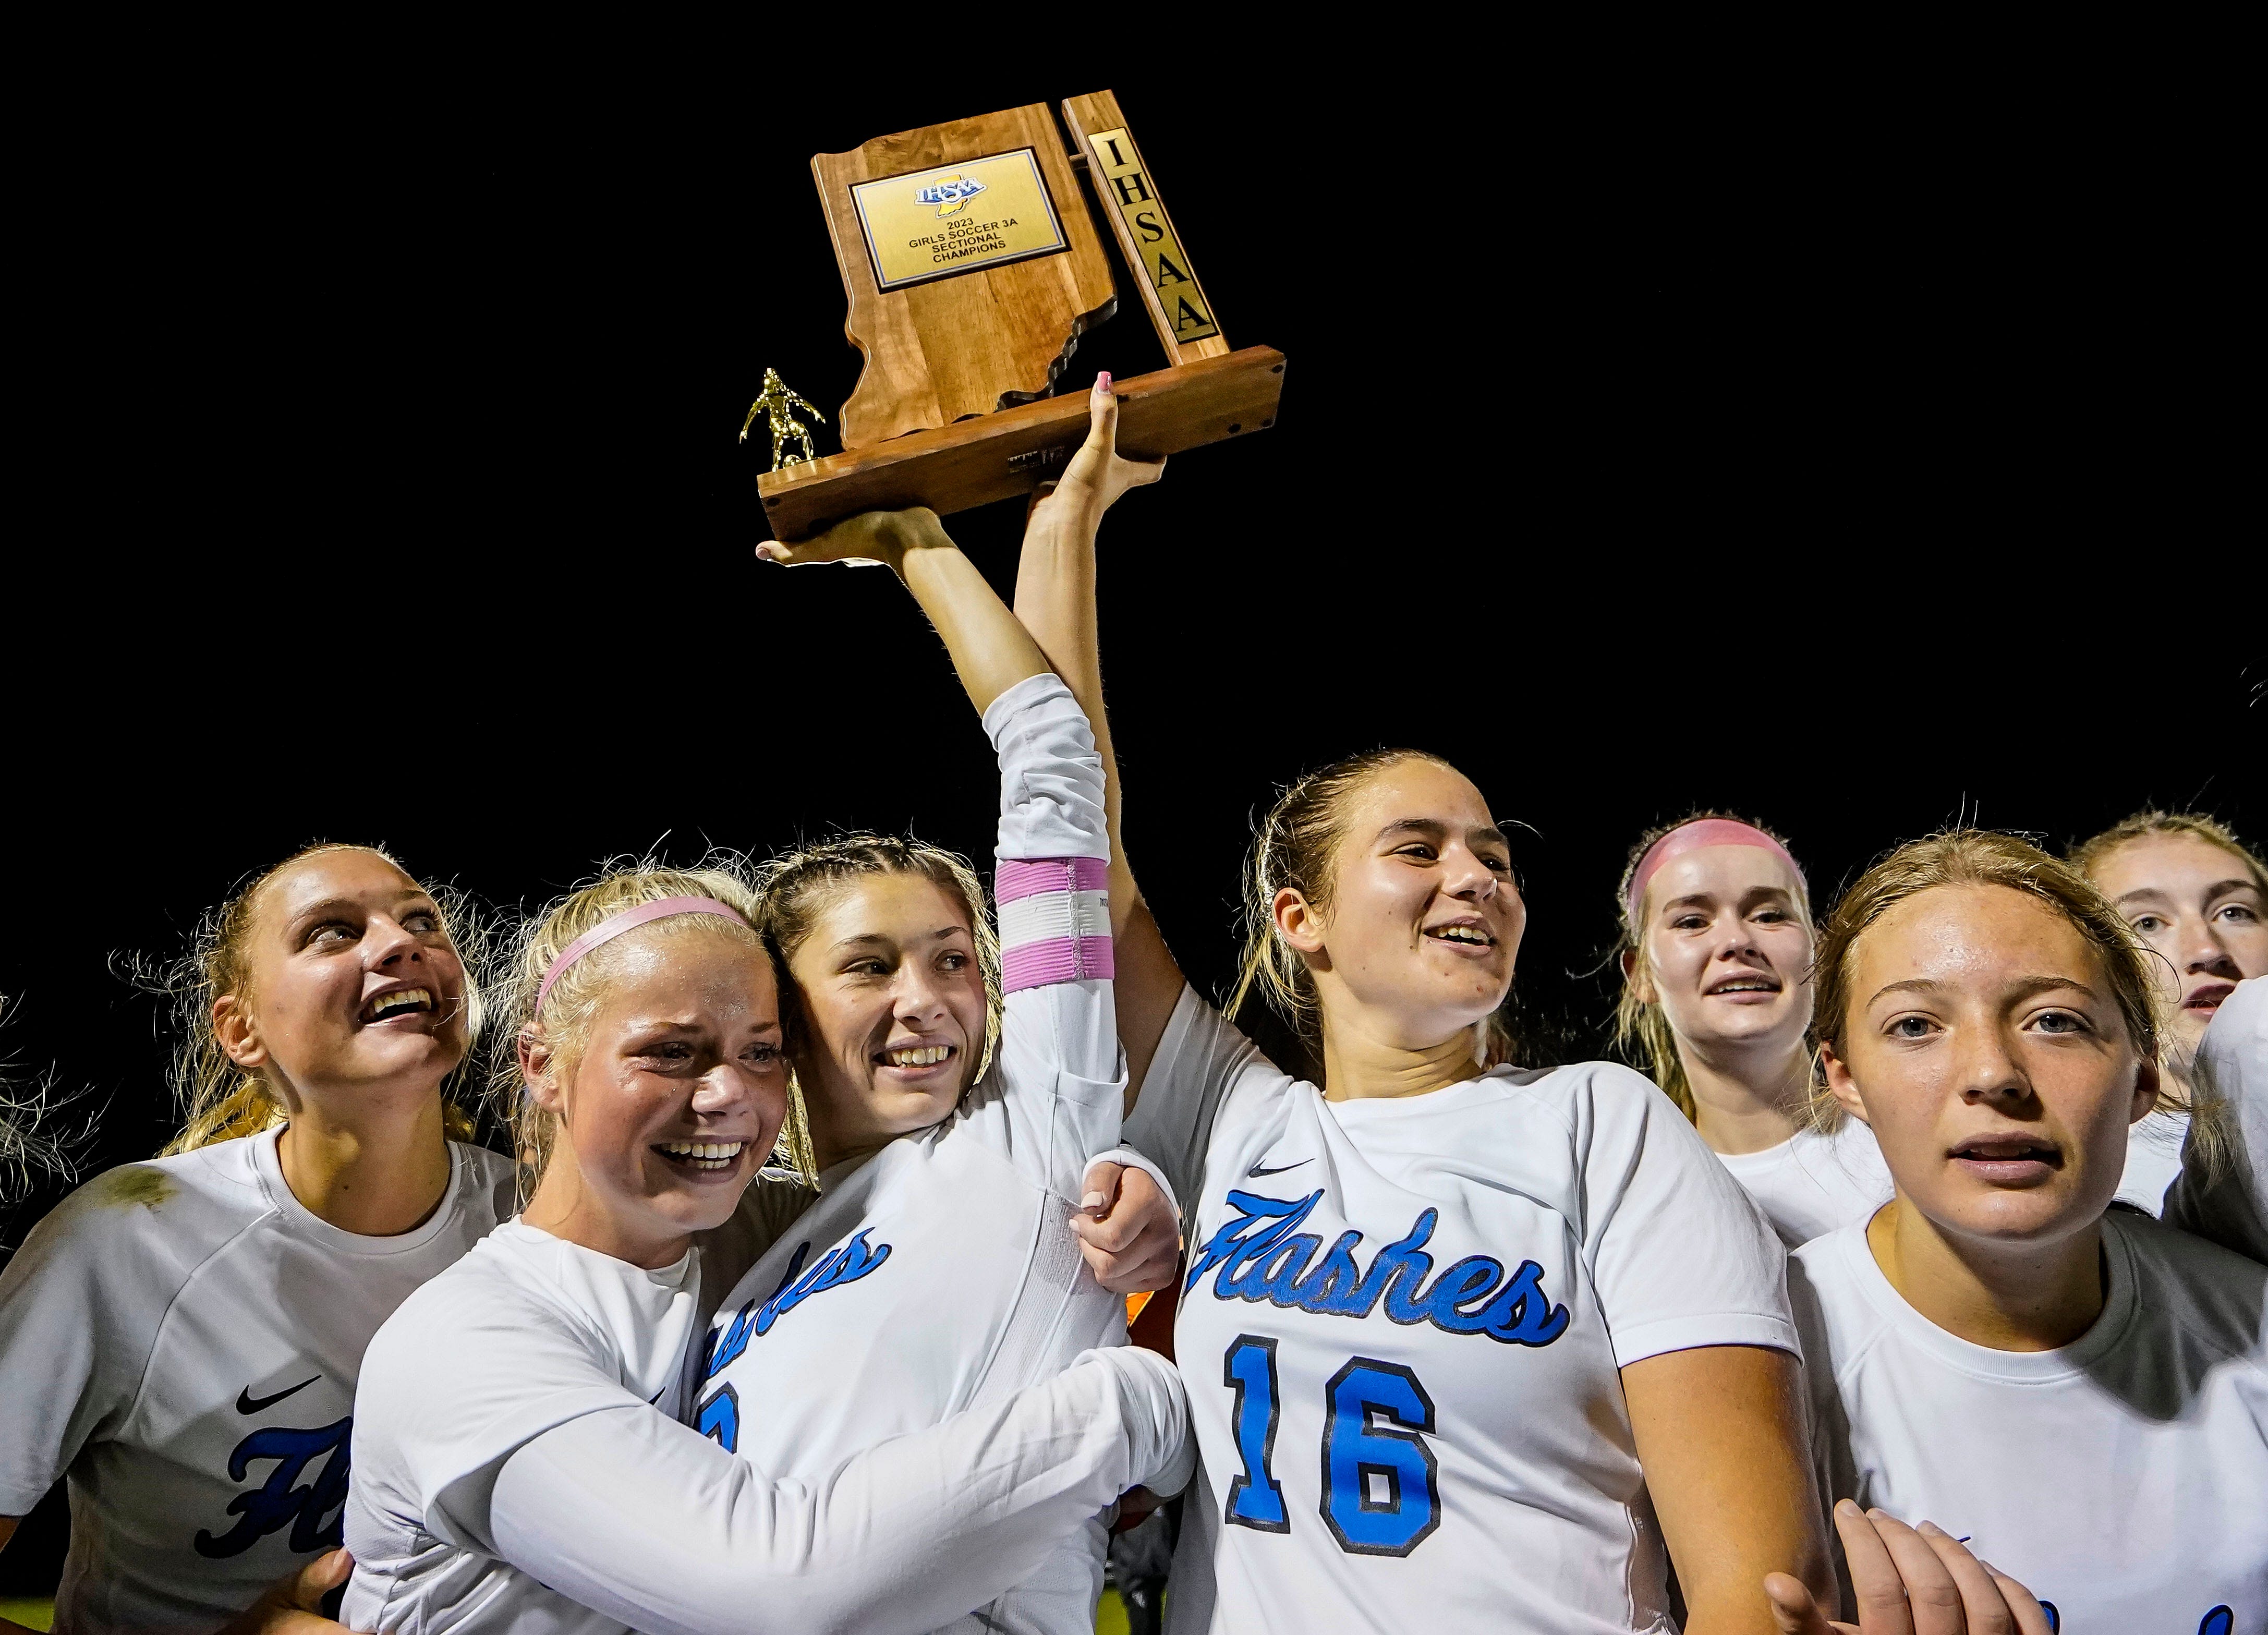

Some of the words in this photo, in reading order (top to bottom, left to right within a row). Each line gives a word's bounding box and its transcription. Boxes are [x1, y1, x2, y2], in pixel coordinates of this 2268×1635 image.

[915, 177, 986, 204] IHSAA
[908, 234, 945, 248] GIRLS
[949, 222, 999, 239] SOCCER
[1003, 218, 1018, 227] 3A
[947, 217, 974, 229] 2023
[1102, 138, 1210, 332] IHSAA
[931, 232, 1002, 253] SECTIONAL
[932, 240, 1006, 263] CHAMPIONS
[1183, 1189, 1570, 1348] Flashes
[1223, 1333, 1441, 1558] 16
